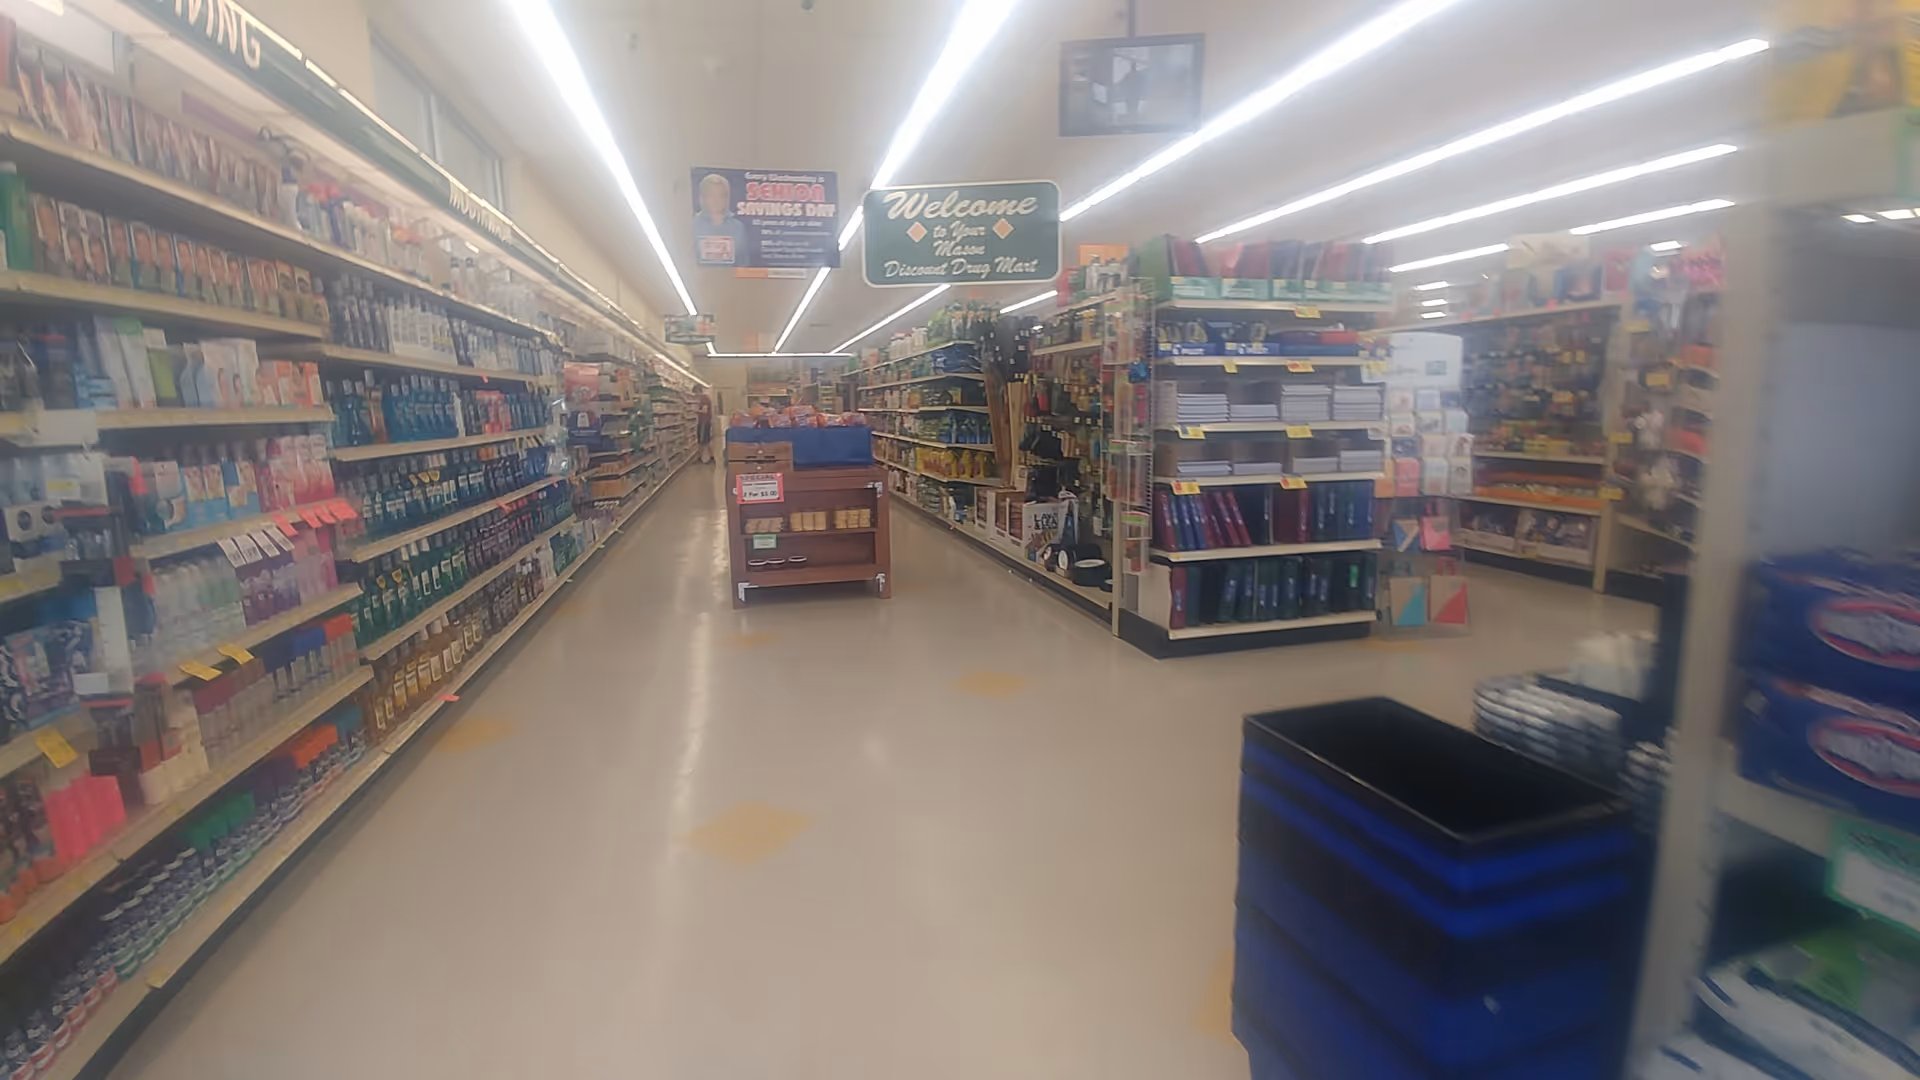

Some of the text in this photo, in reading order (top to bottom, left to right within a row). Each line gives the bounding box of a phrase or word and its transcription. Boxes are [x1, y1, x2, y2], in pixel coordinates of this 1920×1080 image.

[746, 182, 825, 202] SENIOR
[737, 201, 836, 217] SAVINGS DAY
[882, 190, 1038, 220] Welcome
[933, 220, 985, 242] to Your
[933, 240, 985, 256] Mason
[884, 256, 1038, 278] Discount Drug Mart
